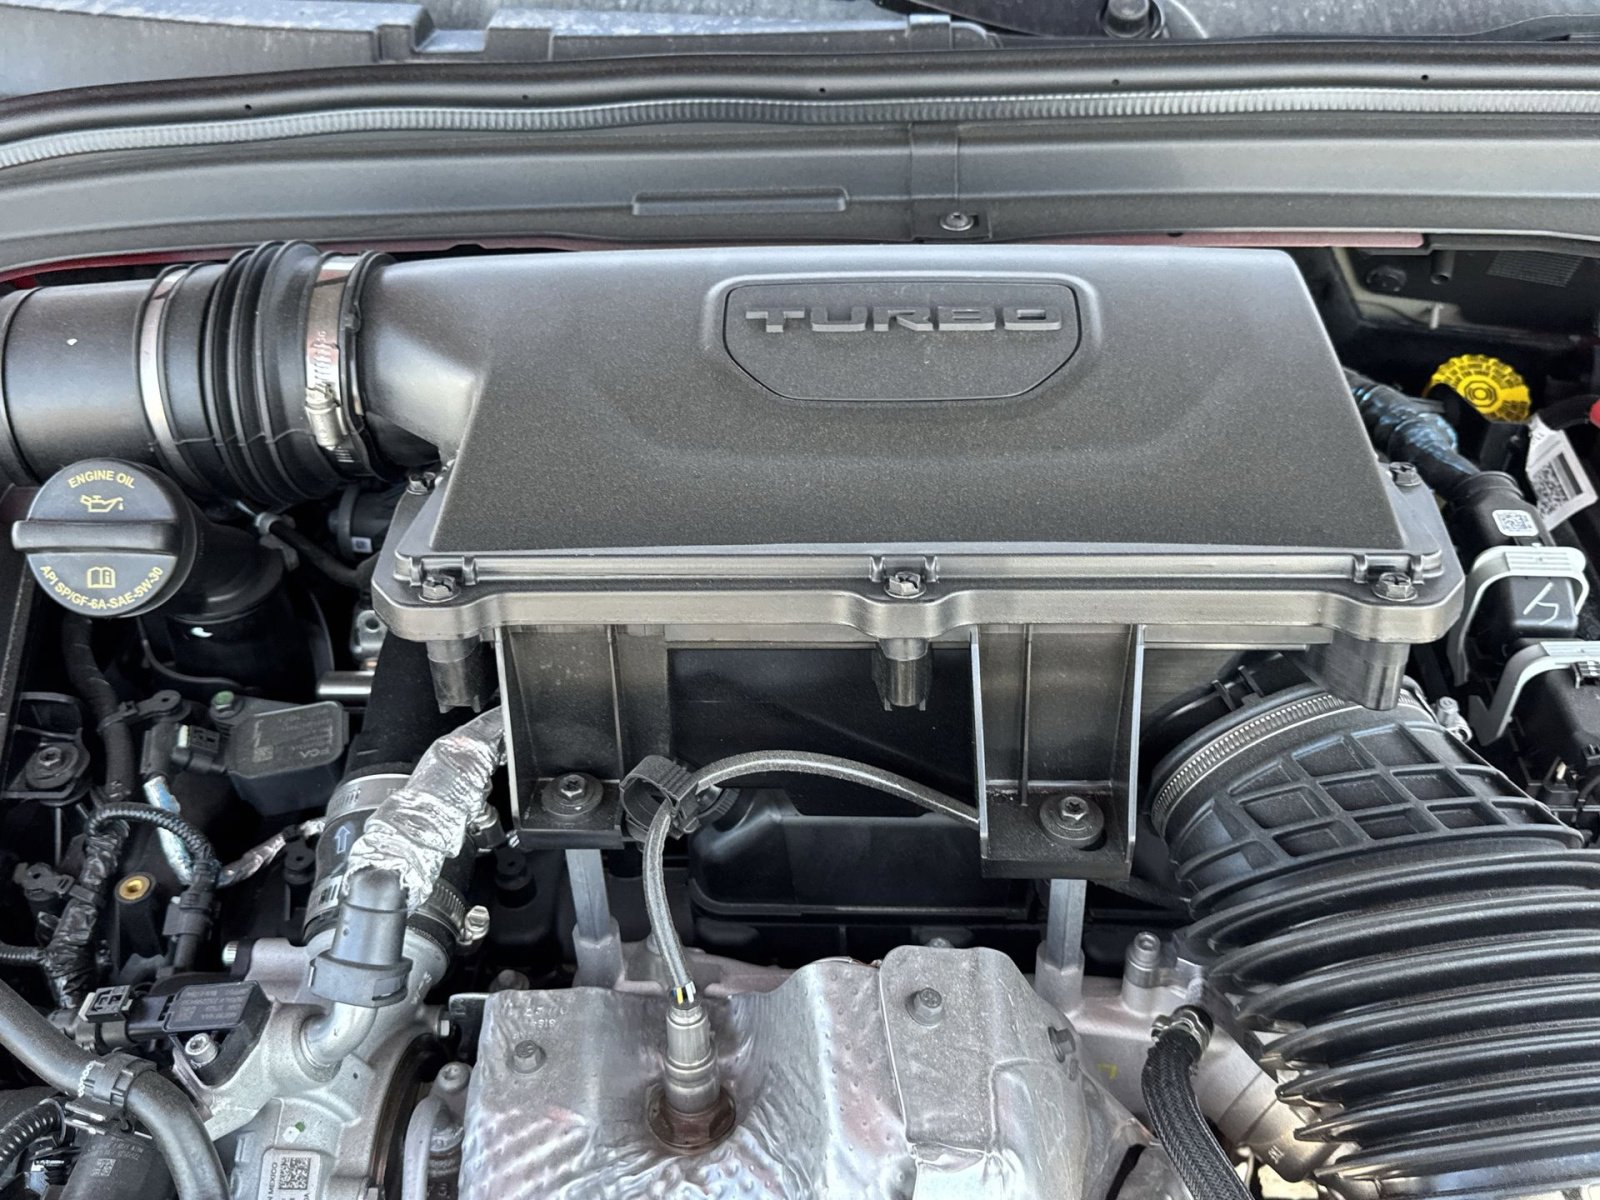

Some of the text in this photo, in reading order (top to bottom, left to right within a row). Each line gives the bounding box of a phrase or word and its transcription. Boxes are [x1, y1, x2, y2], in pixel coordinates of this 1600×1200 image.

[744, 305, 1063, 334] TURBO
[68, 470, 136, 489] ENGINE OIL
[40, 565, 59, 585] API
